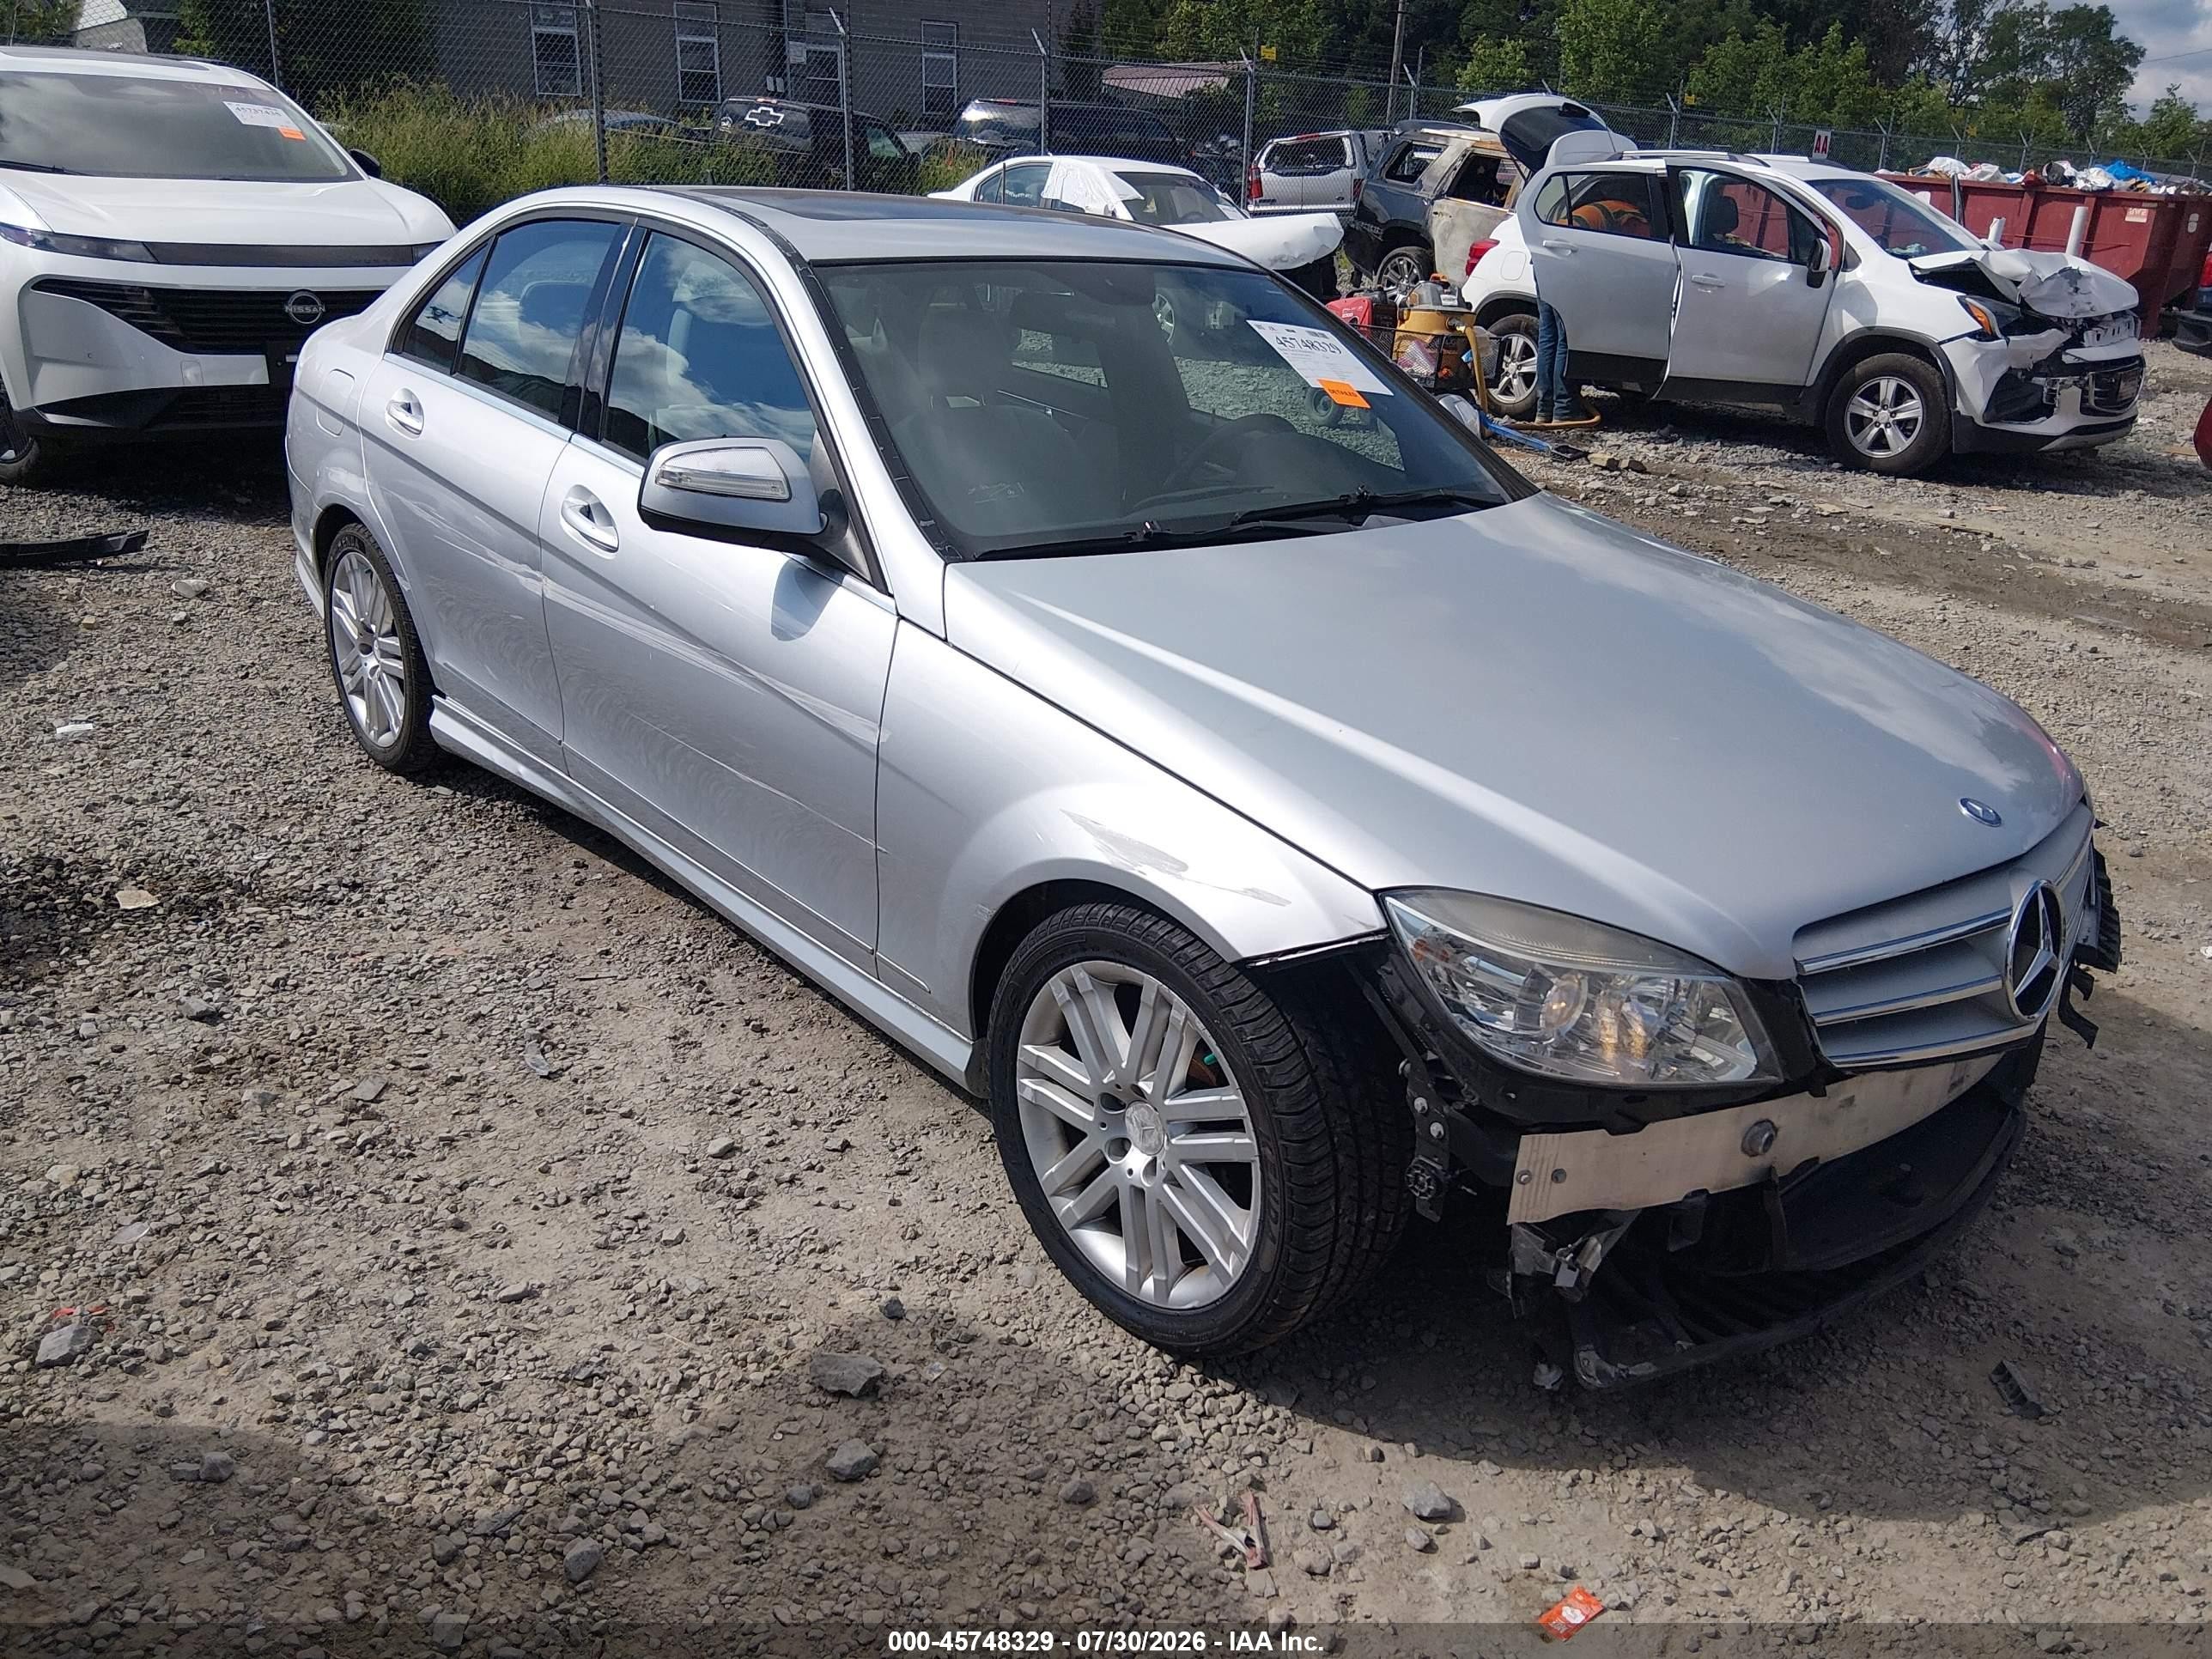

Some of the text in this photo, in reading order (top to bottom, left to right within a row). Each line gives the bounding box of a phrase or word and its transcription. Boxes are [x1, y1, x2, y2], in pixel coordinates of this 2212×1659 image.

[1814, 134, 1828, 155] AA
[284, 304, 325, 313] NISSAN
[1275, 335, 1342, 355] 45748329
